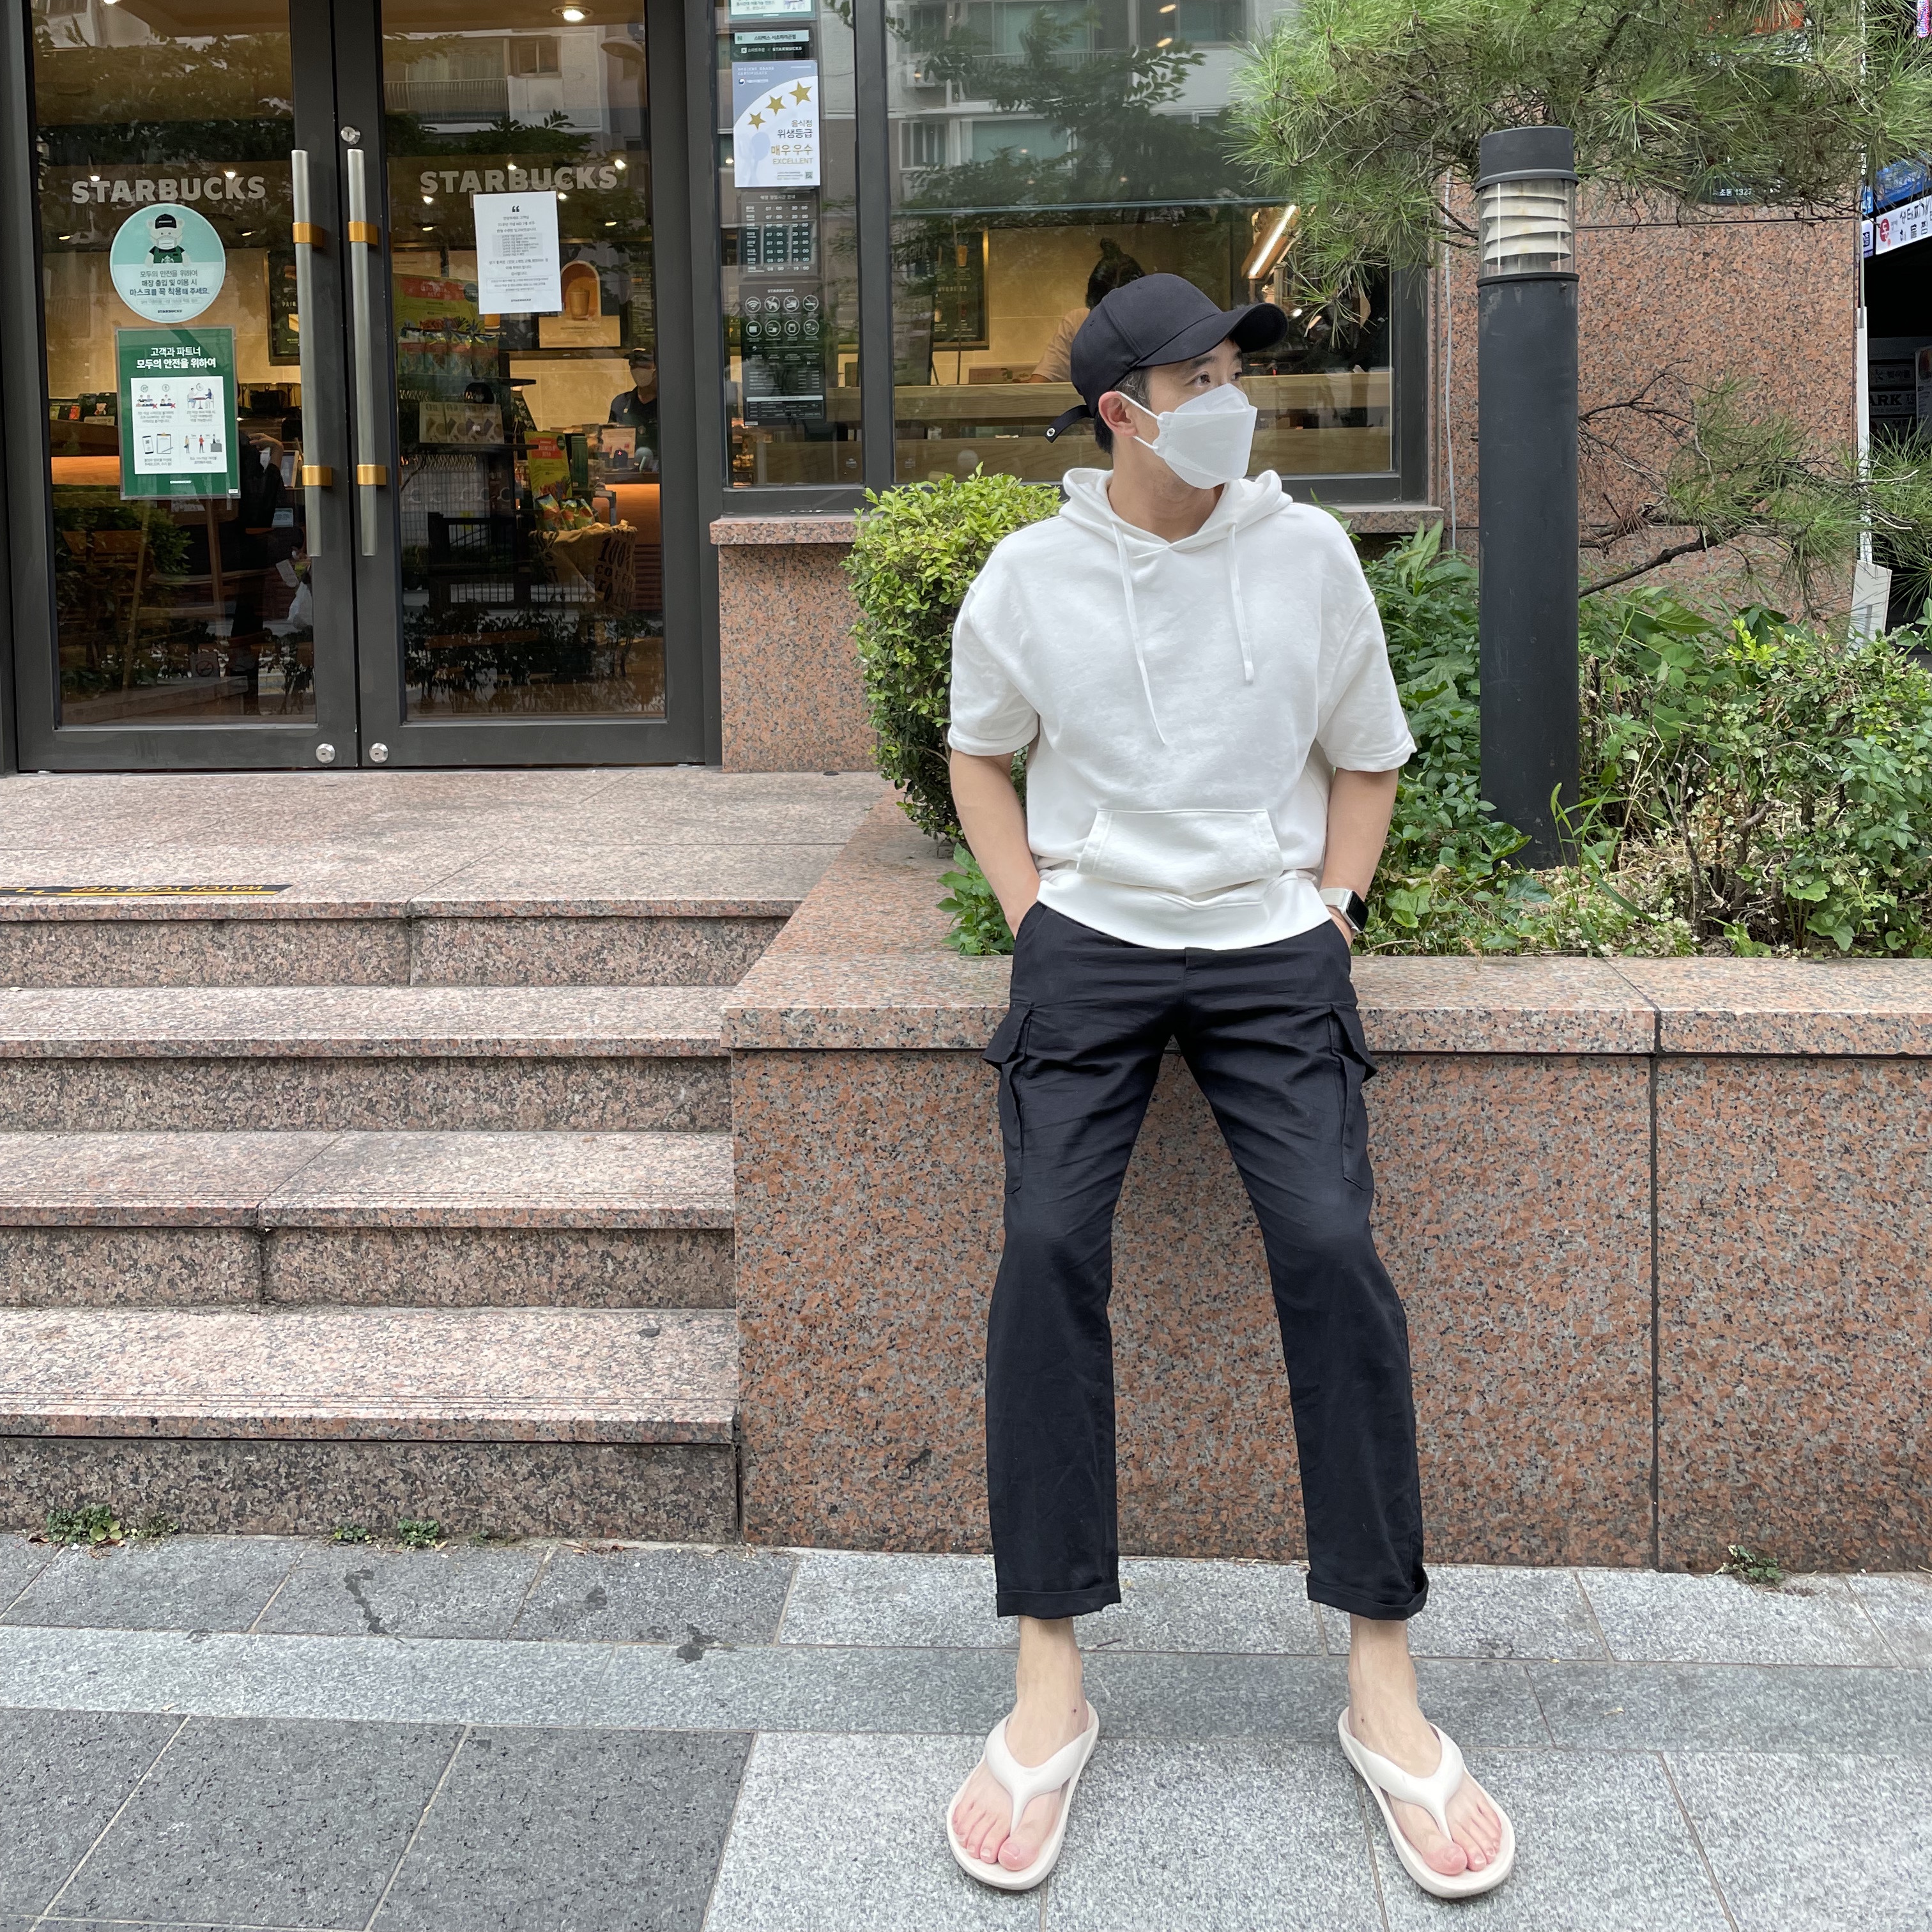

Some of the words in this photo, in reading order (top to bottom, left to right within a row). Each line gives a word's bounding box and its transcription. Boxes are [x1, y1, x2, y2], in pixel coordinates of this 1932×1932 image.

[777, 129, 813, 138] 위생등급
[771, 144, 791, 156] 매우
[793, 144, 813, 155] 우수
[420, 166, 618, 194] STARBUCKS
[72, 176, 266, 204] STARBUCKS
[150, 347, 175, 357] 고객과
[176, 346, 201, 356] 파트너
[136, 359, 162, 370] 모두의
[163, 358, 189, 369] 안전을
[190, 357, 216, 368] 위하여
